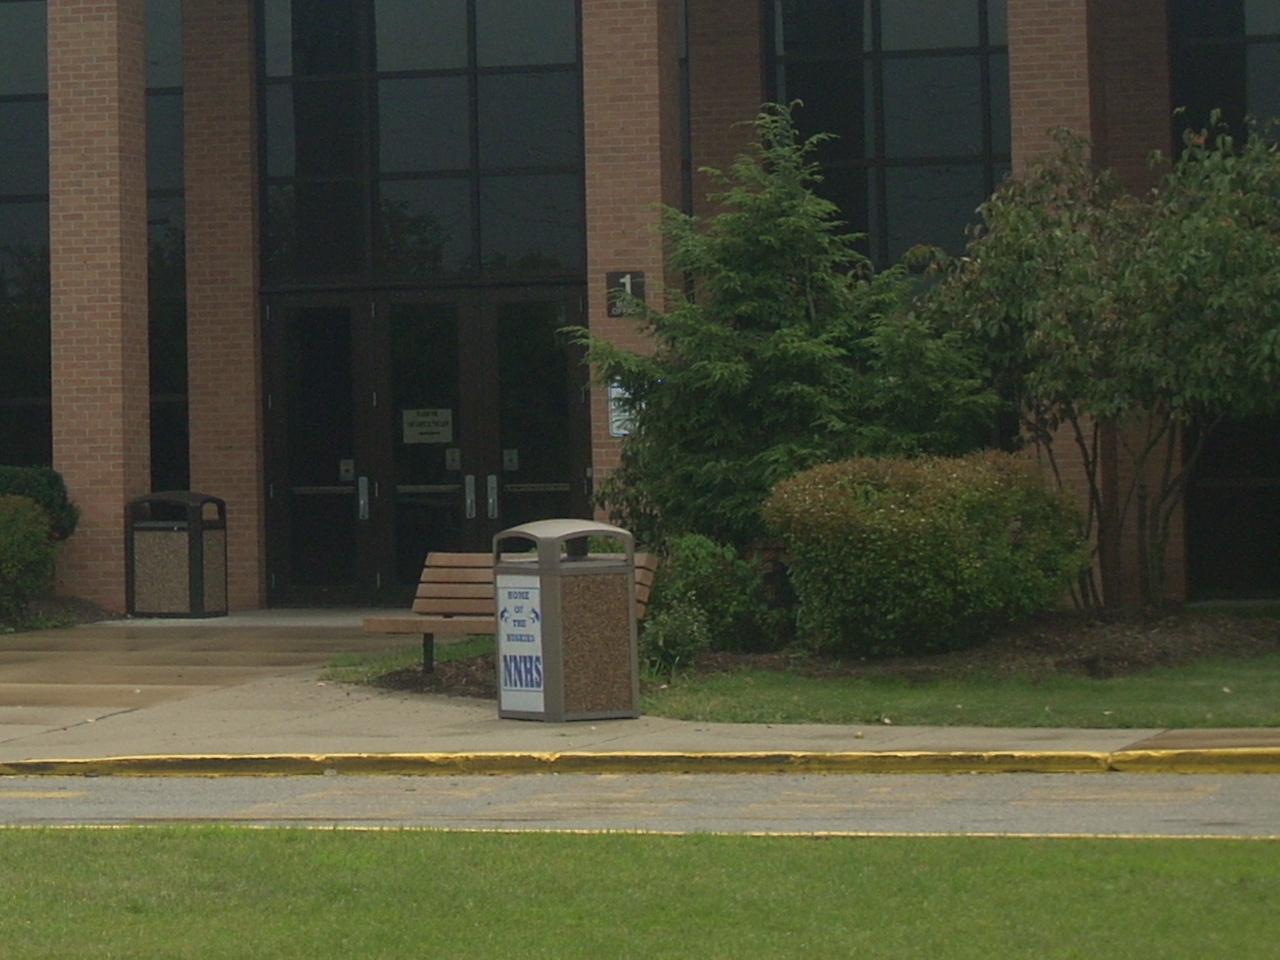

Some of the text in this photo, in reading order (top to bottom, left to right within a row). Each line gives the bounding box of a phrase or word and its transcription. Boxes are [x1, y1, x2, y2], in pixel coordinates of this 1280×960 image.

[619, 274, 631, 295] 1
[508, 591, 530, 600] HOME
[513, 605, 524, 614] OF
[513, 619, 526, 627] THE
[503, 655, 542, 688] NNHS
